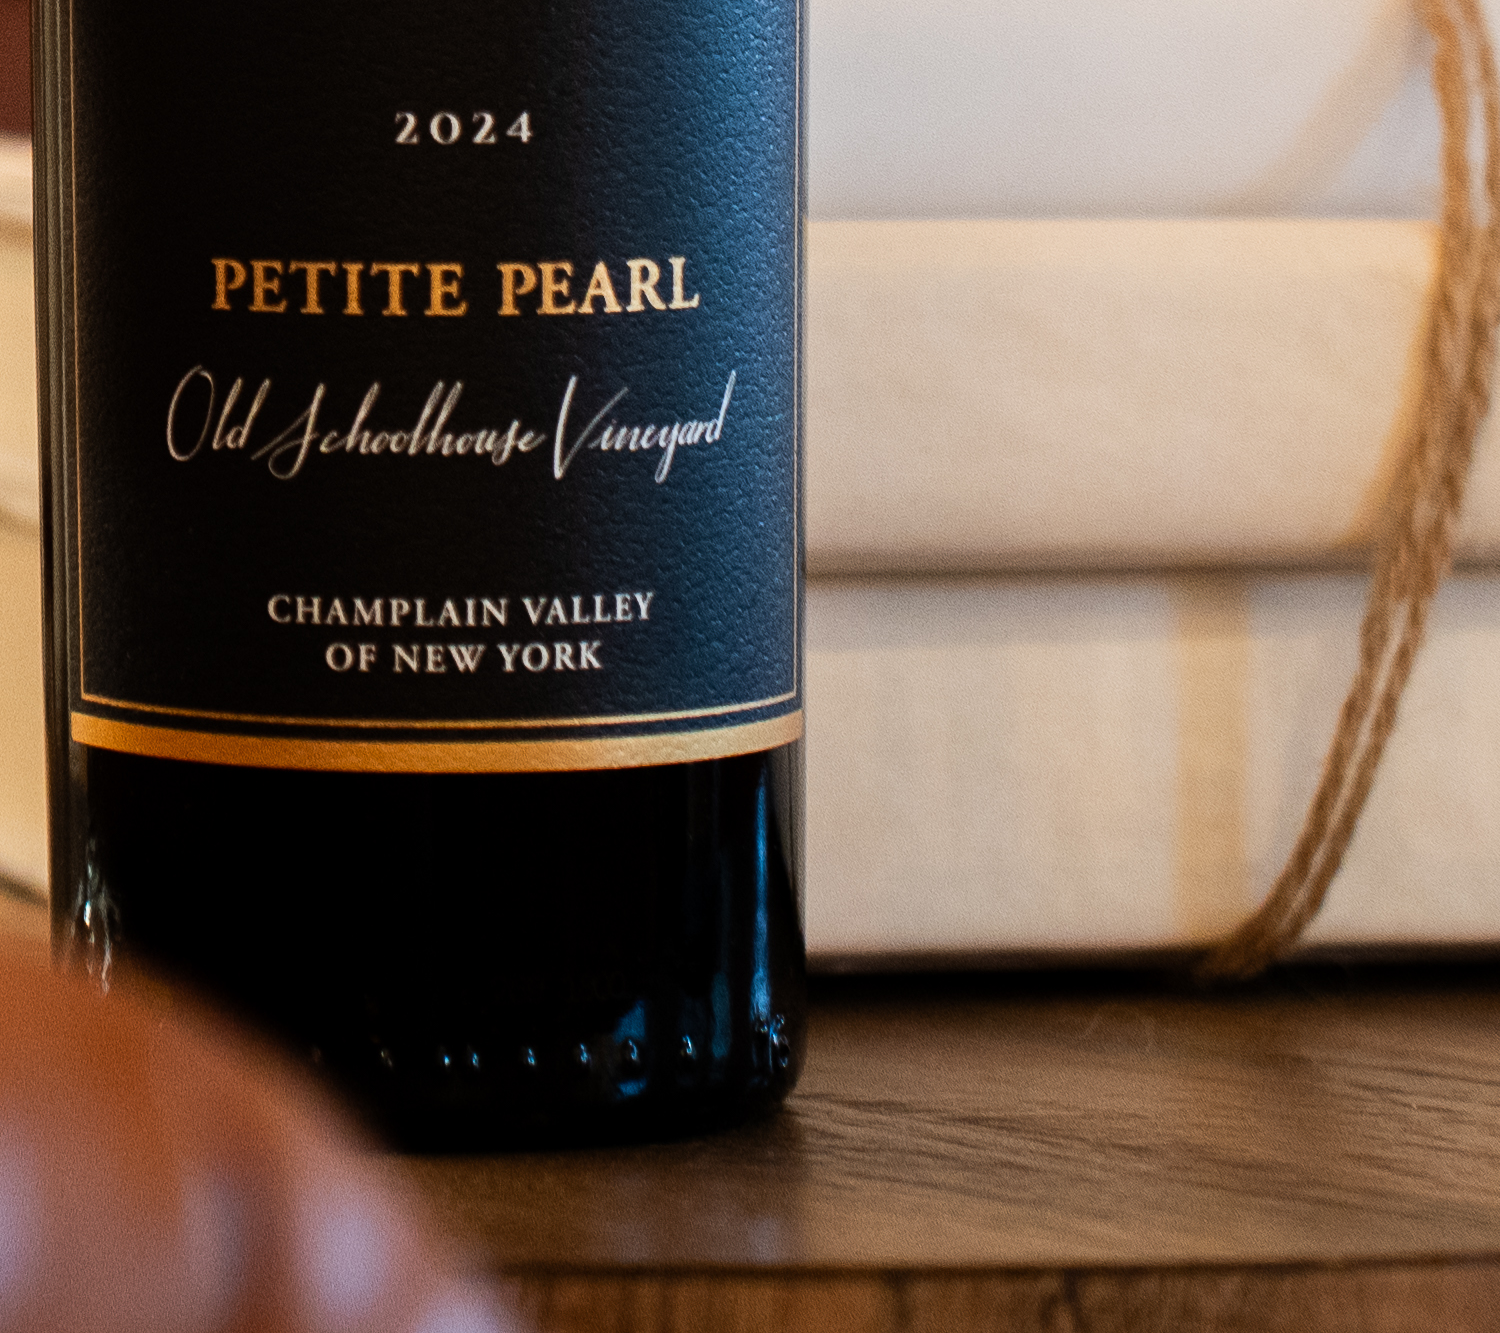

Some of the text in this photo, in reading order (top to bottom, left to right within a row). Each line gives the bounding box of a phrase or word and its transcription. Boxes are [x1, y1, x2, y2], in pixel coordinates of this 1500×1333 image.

[394, 110, 535, 146] 2024
[210, 255, 702, 318] PETITE PEARL
[166, 364, 738, 484] Old Schoolhouse Vineyard
[266, 590, 655, 629] CHAMPLAIN VALLEY
[324, 640, 604, 675] OF NEW YORK
